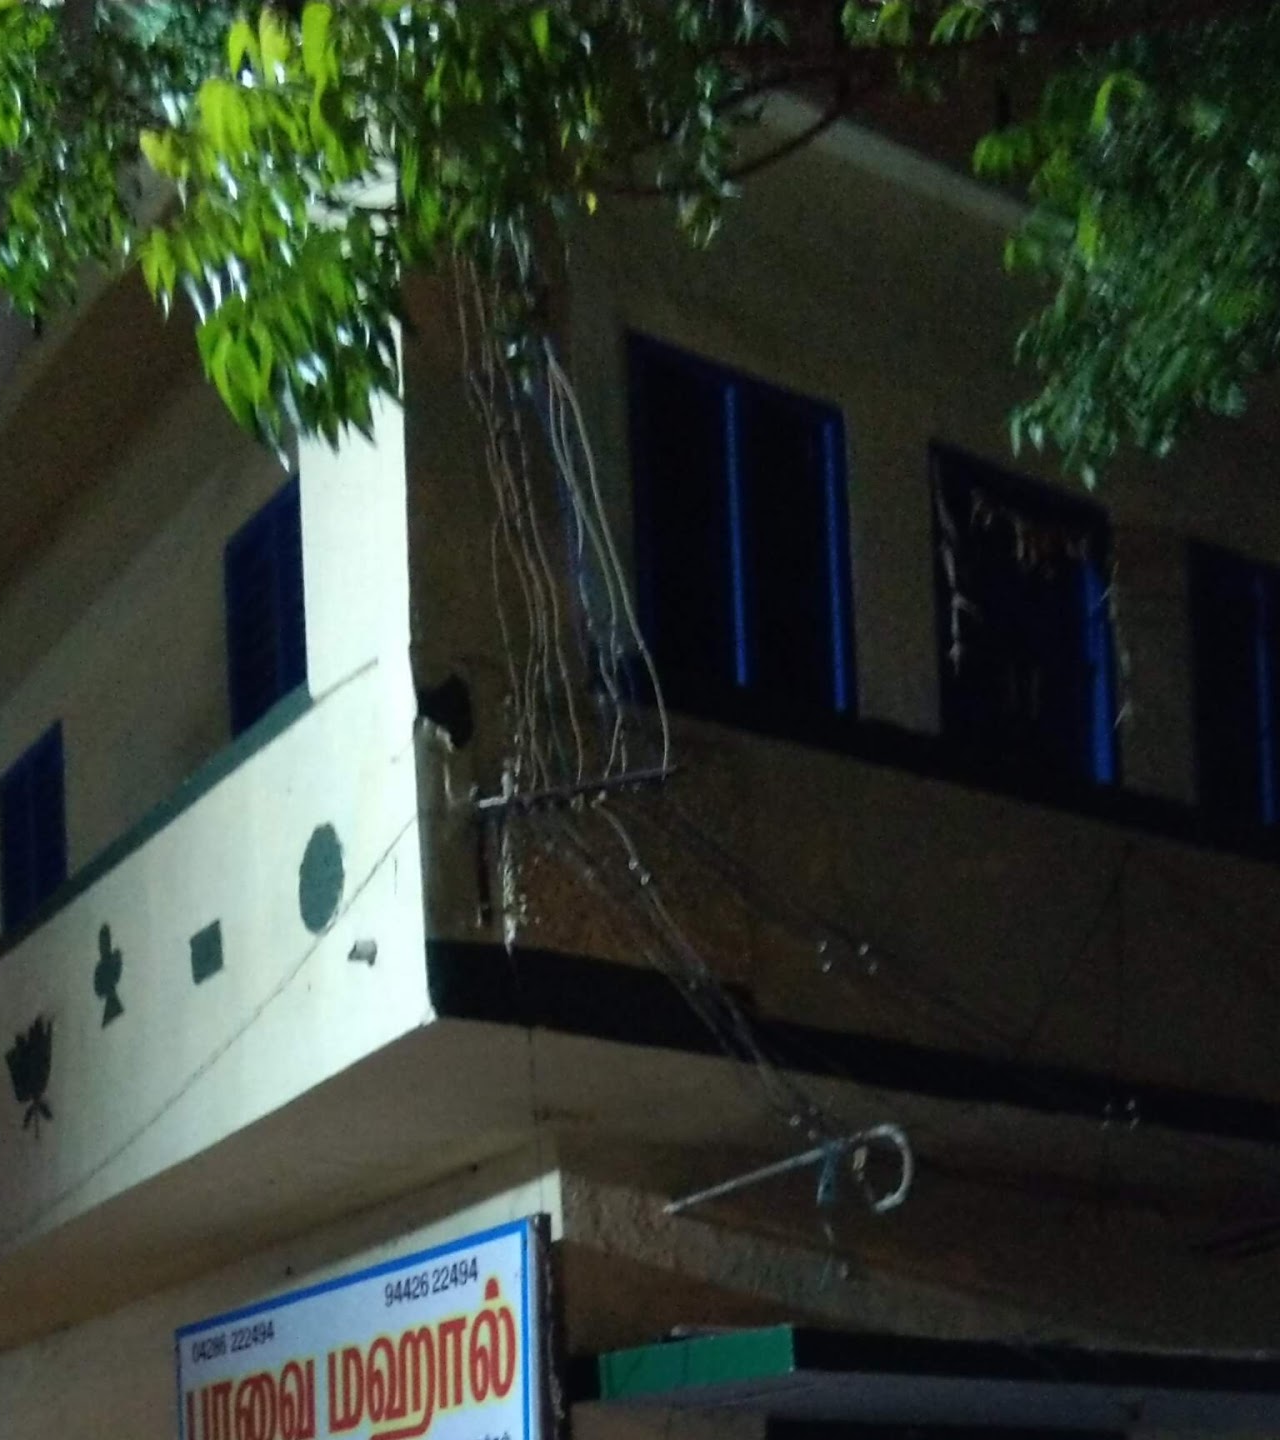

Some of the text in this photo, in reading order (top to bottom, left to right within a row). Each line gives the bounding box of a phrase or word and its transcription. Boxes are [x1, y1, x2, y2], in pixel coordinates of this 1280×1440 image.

[384, 1256, 478, 1307] 94426 22494
[230, 1321, 275, 1353] 222494
